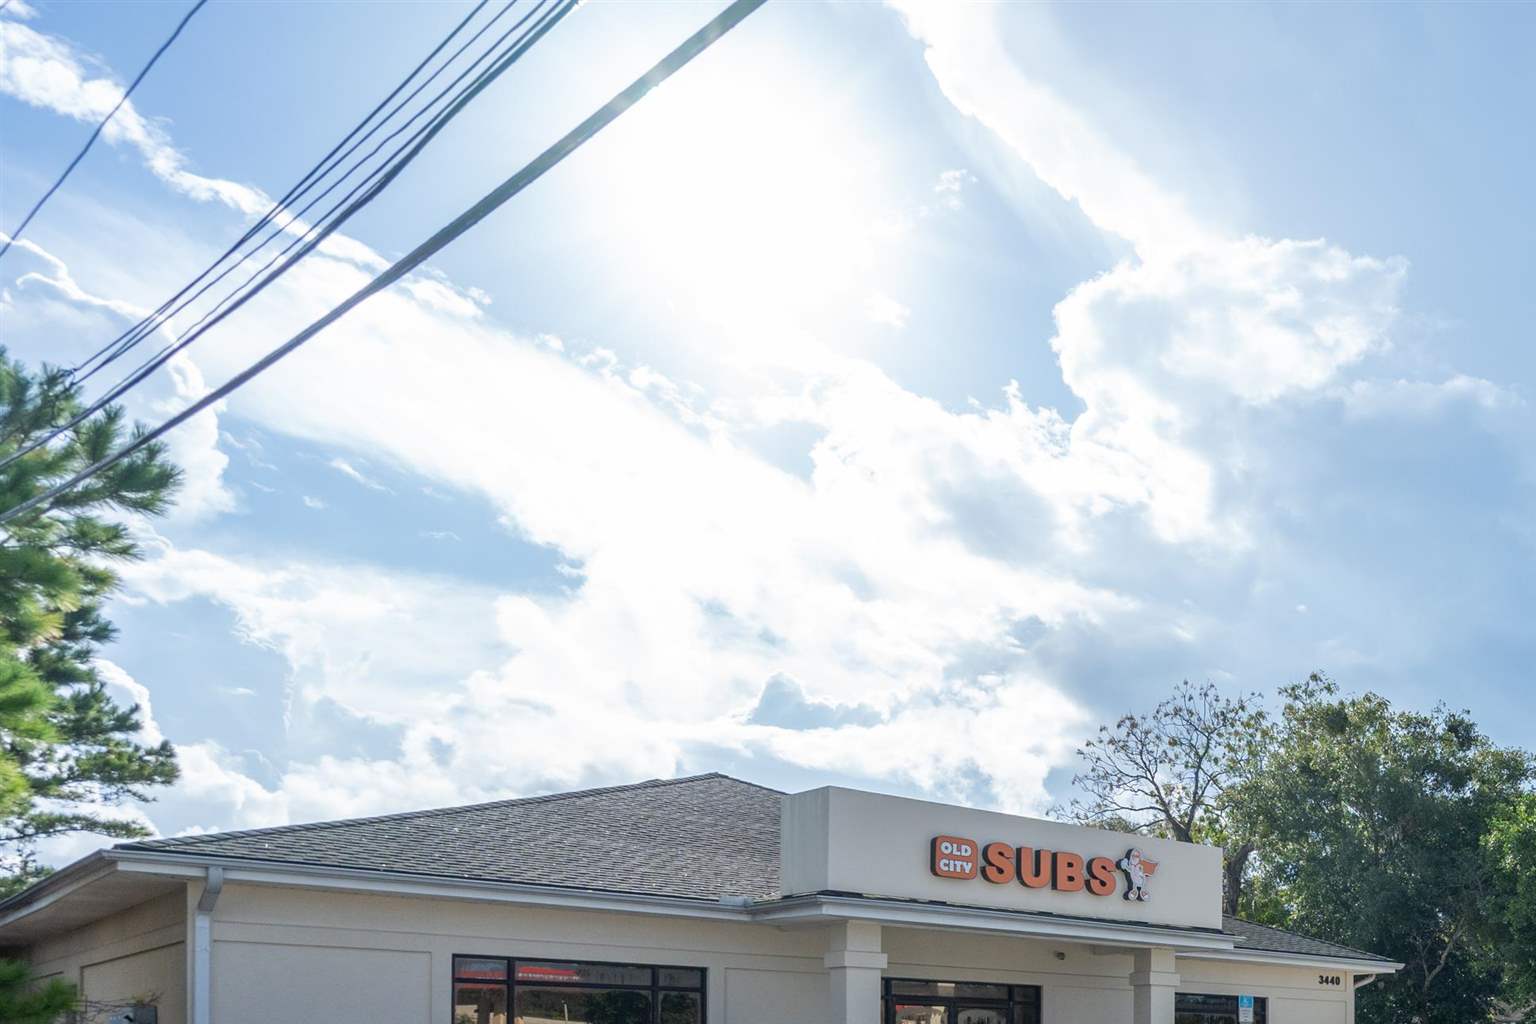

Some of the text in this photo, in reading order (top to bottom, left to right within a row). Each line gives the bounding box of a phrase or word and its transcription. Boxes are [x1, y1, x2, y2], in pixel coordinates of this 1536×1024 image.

[940, 841, 972, 857] OLD
[939, 858, 972, 874] CITY
[981, 842, 1117, 896] SUBS
[1318, 975, 1341, 986] 3440
